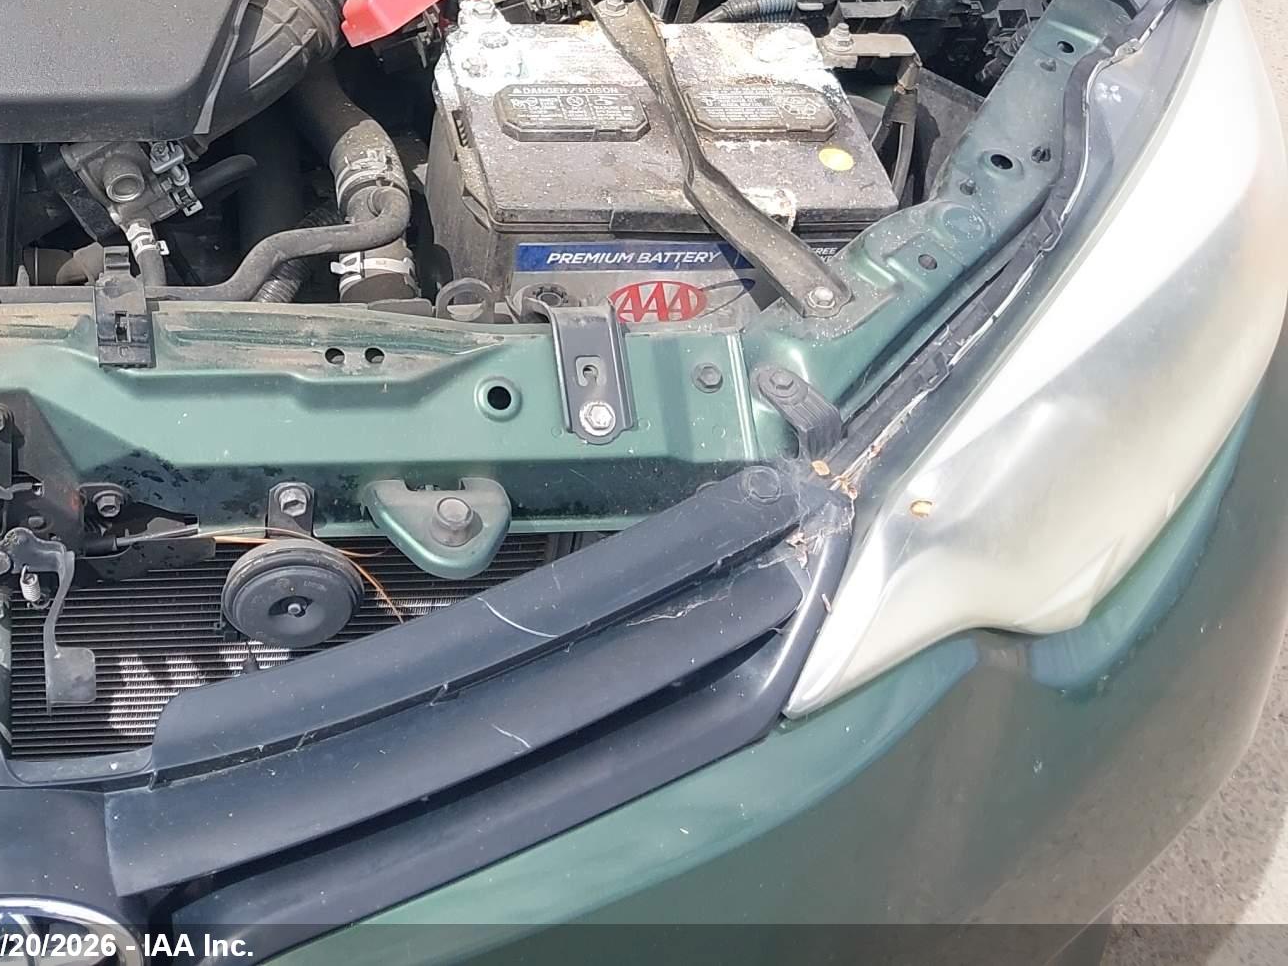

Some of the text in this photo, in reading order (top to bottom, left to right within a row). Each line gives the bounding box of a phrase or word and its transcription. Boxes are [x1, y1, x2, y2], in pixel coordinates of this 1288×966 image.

[523, 87, 568, 95] DANGER
[578, 87, 619, 95] POISON
[546, 251, 722, 264] PREMIUM BATTERY
[616, 281, 697, 322] AAA
